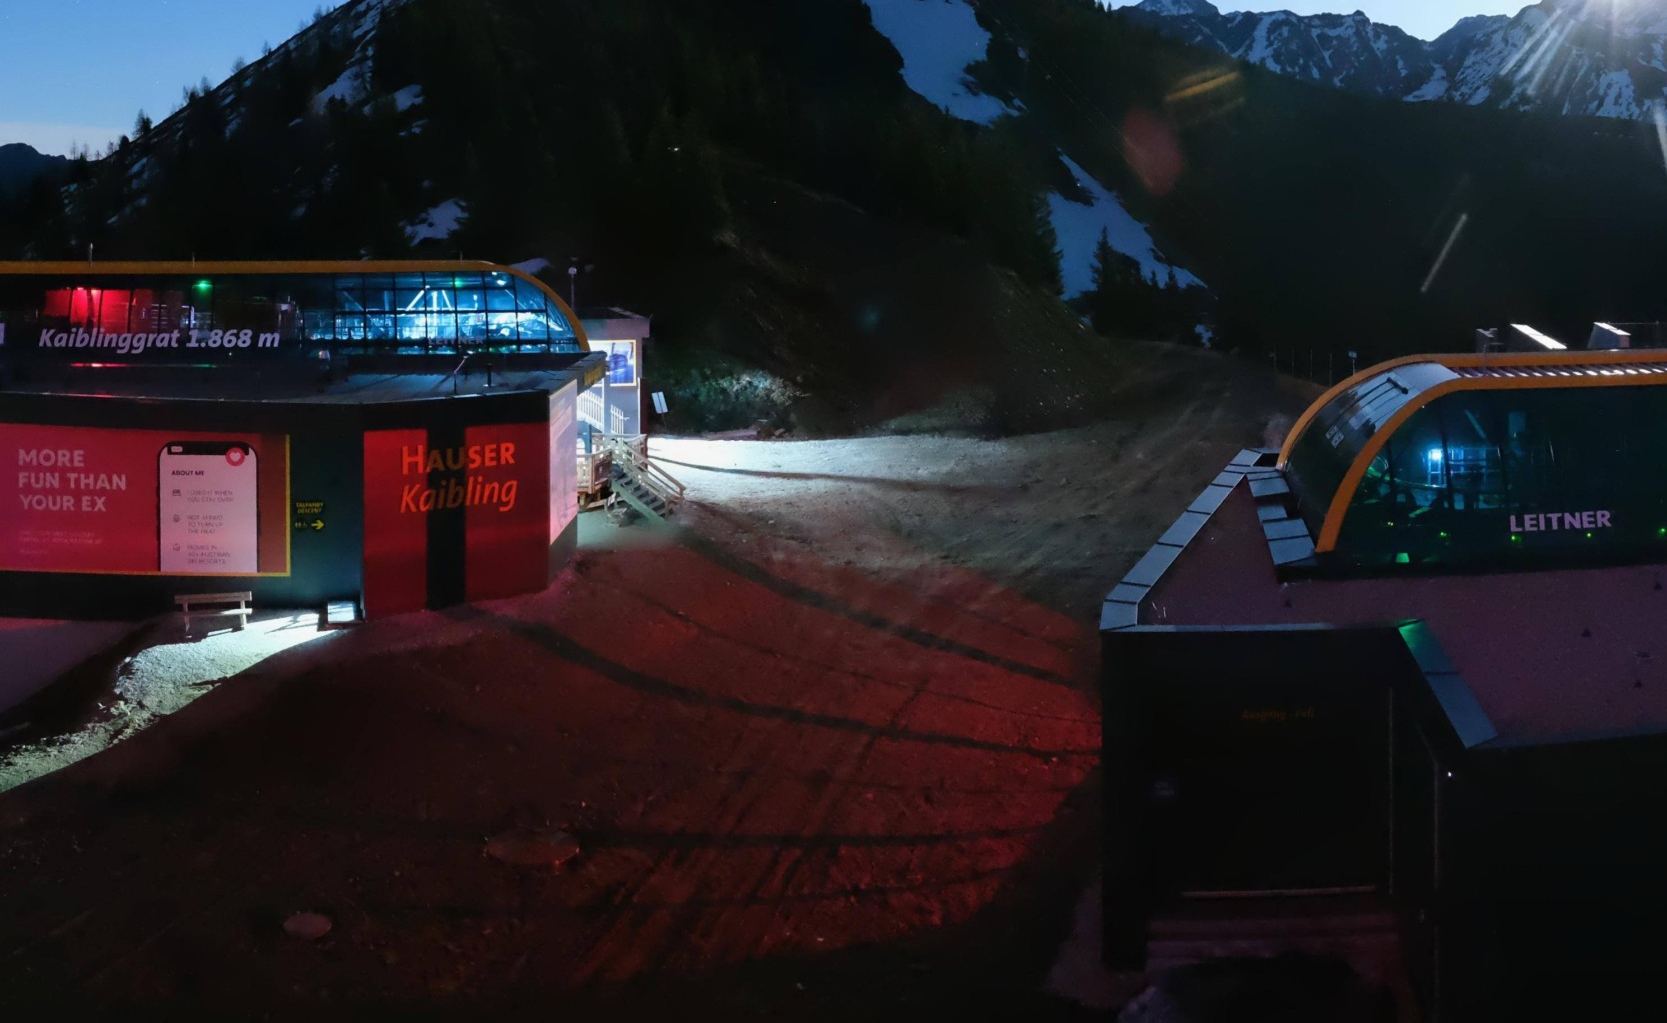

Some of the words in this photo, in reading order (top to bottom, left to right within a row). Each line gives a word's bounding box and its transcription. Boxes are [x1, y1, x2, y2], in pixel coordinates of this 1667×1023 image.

[38, 328, 180, 353] Kaiblinggrat
[186, 329, 251, 348] 1.868
[258, 333, 281, 348] m
[428, 336, 484, 345] LEITNER
[18, 449, 84, 467] MORE
[401, 442, 516, 475] HAUSER
[18, 472, 60, 489] FUN
[67, 474, 127, 490] THAN
[20, 494, 75, 511] YOUR
[81, 496, 107, 512] EX
[399, 476, 518, 513] Kaibling
[1510, 510, 1612, 532] LEITNER
